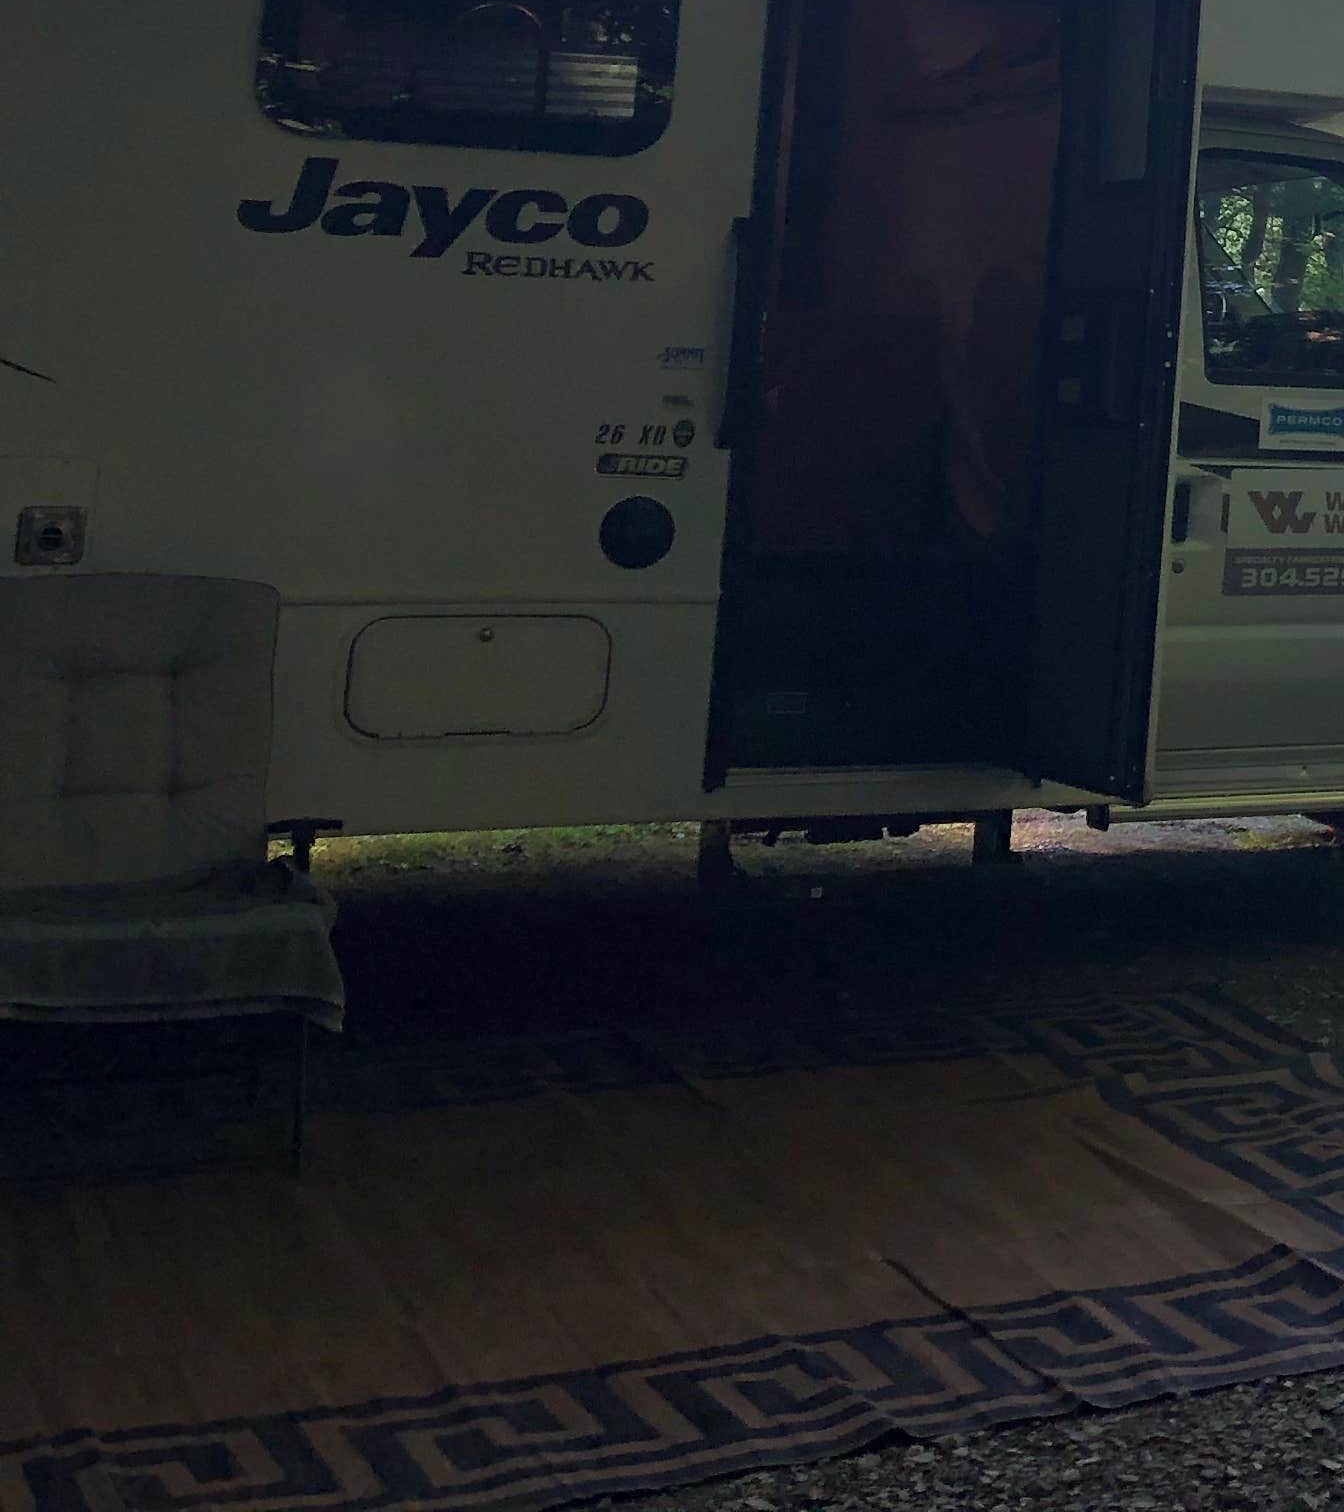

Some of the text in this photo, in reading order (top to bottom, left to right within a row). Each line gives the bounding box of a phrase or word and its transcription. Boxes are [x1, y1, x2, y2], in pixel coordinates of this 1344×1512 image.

[236, 156, 650, 258] Jayco
[1275, 414, 1344, 427] PERMCO
[594, 423, 626, 445] 26
